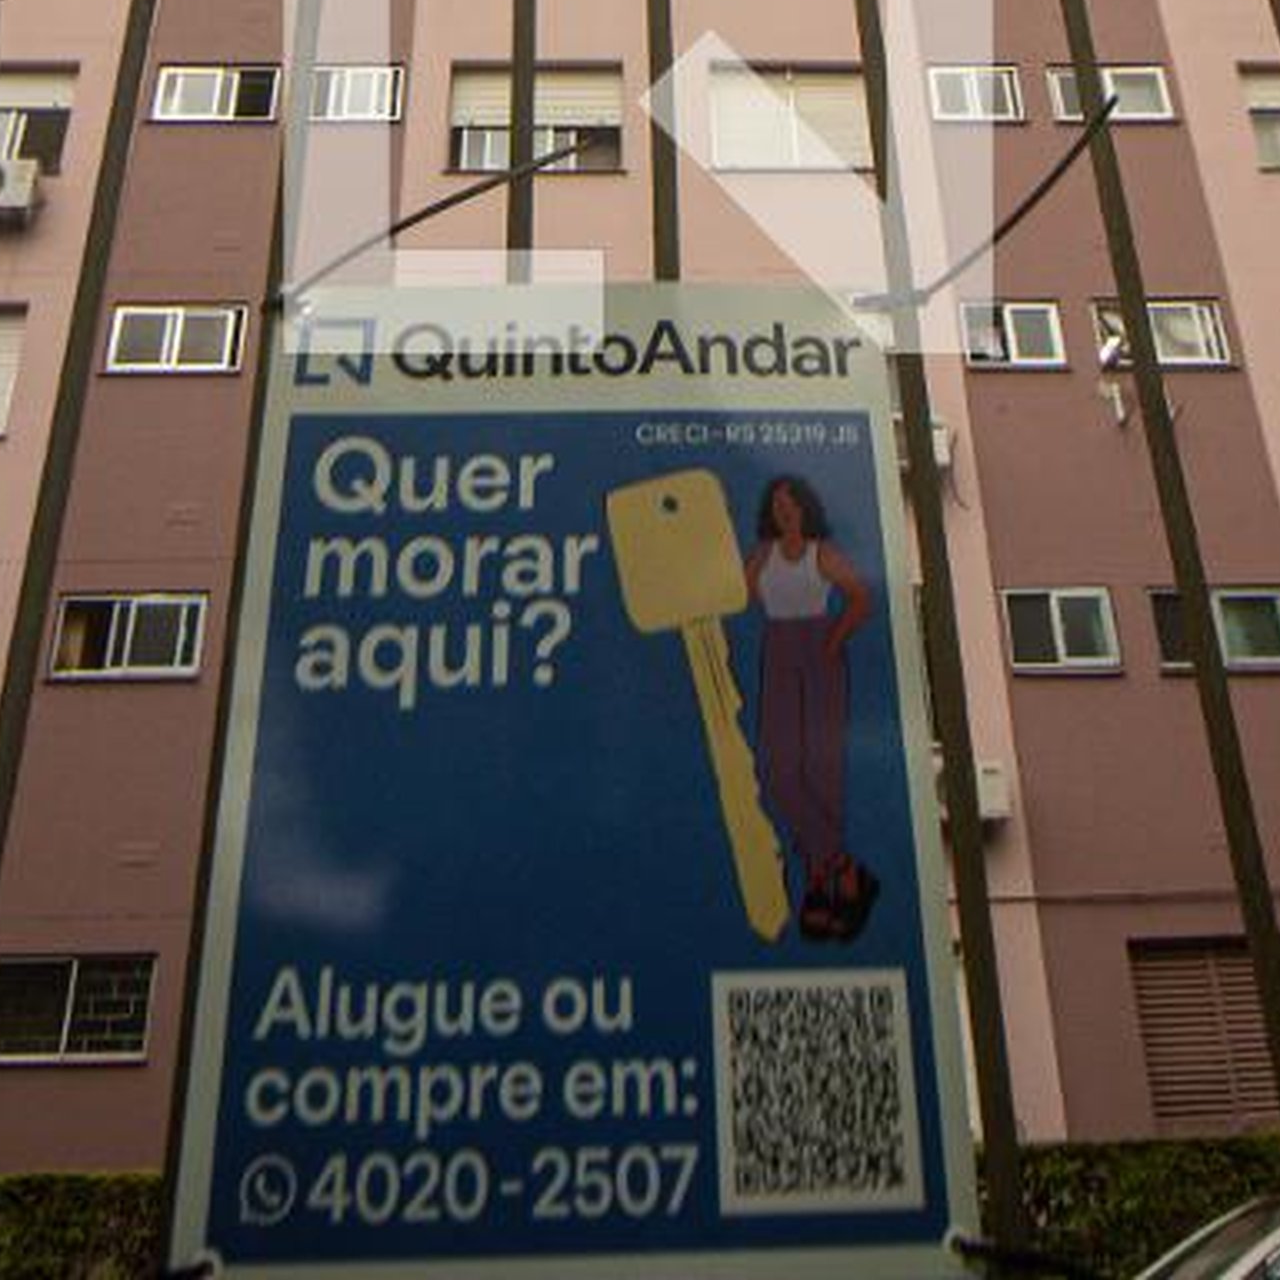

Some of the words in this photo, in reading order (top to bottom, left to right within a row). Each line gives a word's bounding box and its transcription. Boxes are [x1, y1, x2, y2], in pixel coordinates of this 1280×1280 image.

[391, 319, 861, 381] QuintoAndar
[313, 434, 555, 514] Quer
[303, 534, 600, 599] morar
[294, 598, 573, 711] aqui?
[252, 965, 522, 1056] Alugue
[543, 976, 634, 1035] ou
[244, 1060, 543, 1142] compre
[563, 1056, 699, 1118] em:
